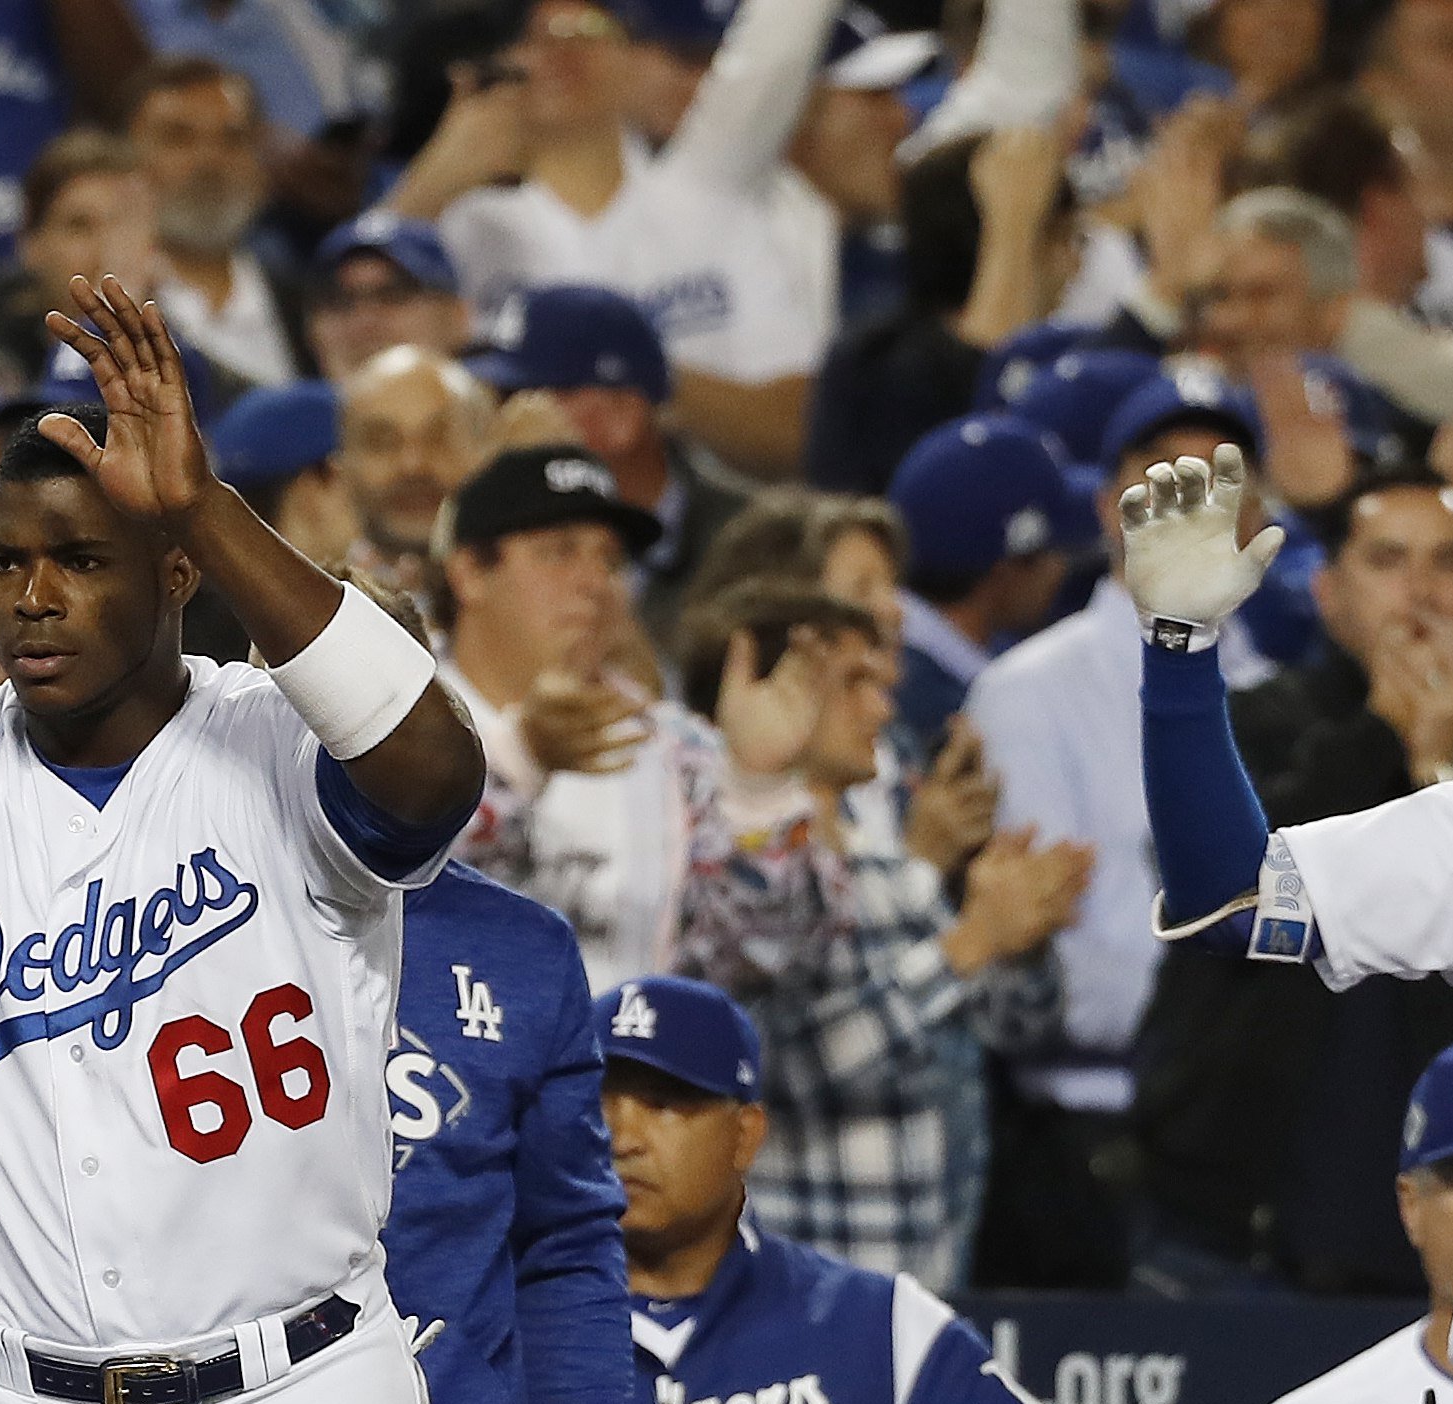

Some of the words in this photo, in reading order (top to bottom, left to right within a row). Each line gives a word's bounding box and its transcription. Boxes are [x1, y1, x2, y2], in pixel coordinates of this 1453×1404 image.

[450, 963, 504, 1042] LA
[611, 982, 659, 1041] LA
[146, 982, 332, 1165] 66
[386, 1053, 442, 1142] S
